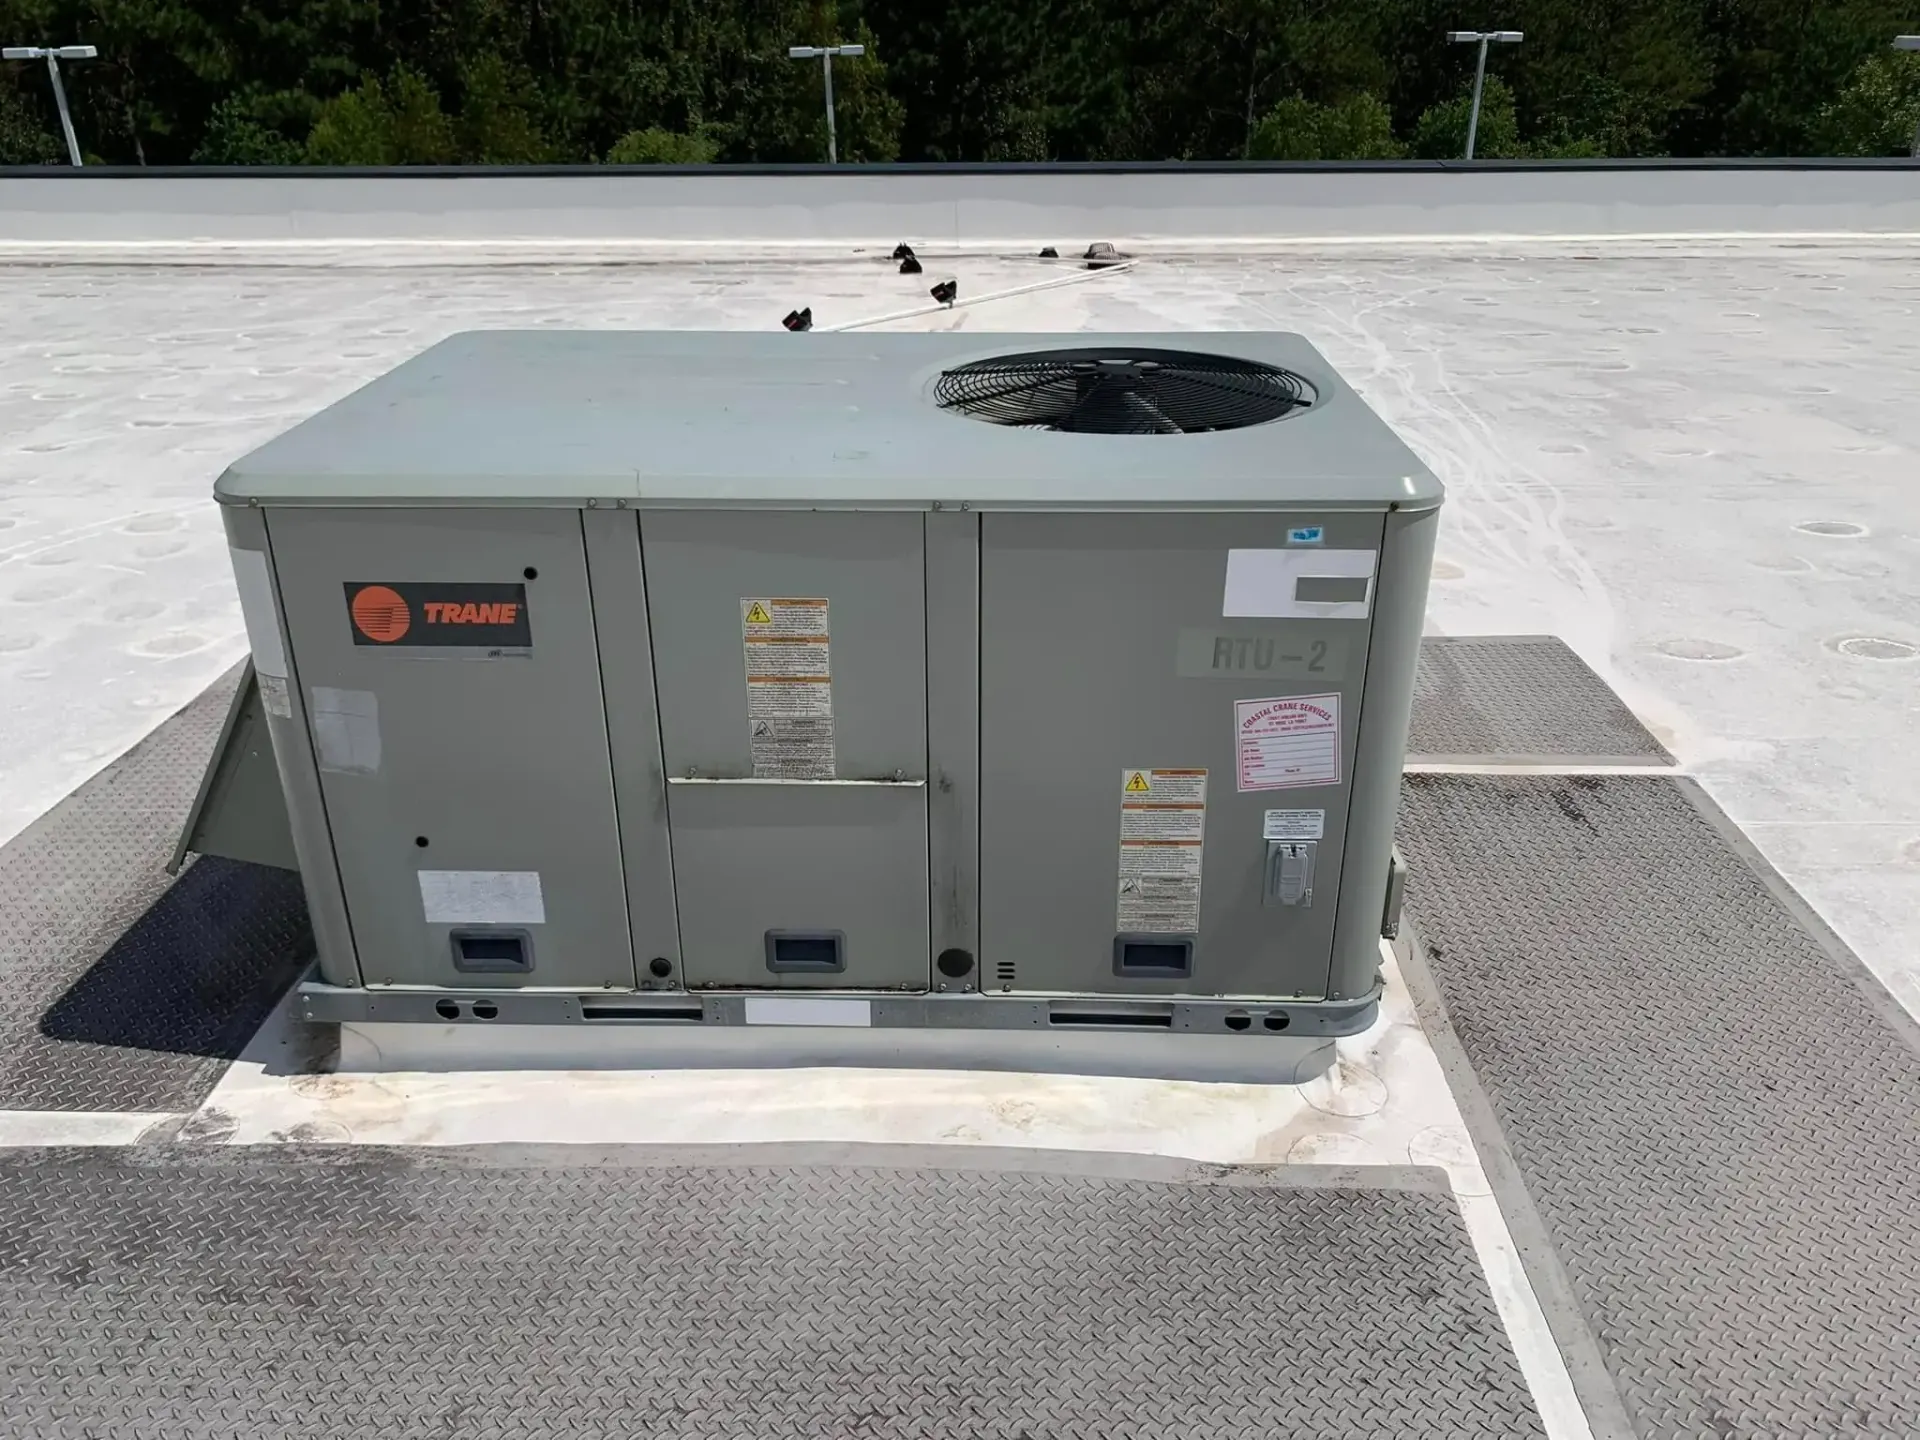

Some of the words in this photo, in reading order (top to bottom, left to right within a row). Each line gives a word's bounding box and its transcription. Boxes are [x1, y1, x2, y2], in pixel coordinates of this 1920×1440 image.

[424, 602, 517, 624] TRANE
[1243, 707, 1272, 729] COASTAL
[1272, 702, 1298, 713] CRANE
[1299, 703, 1332, 721] SERVICES
